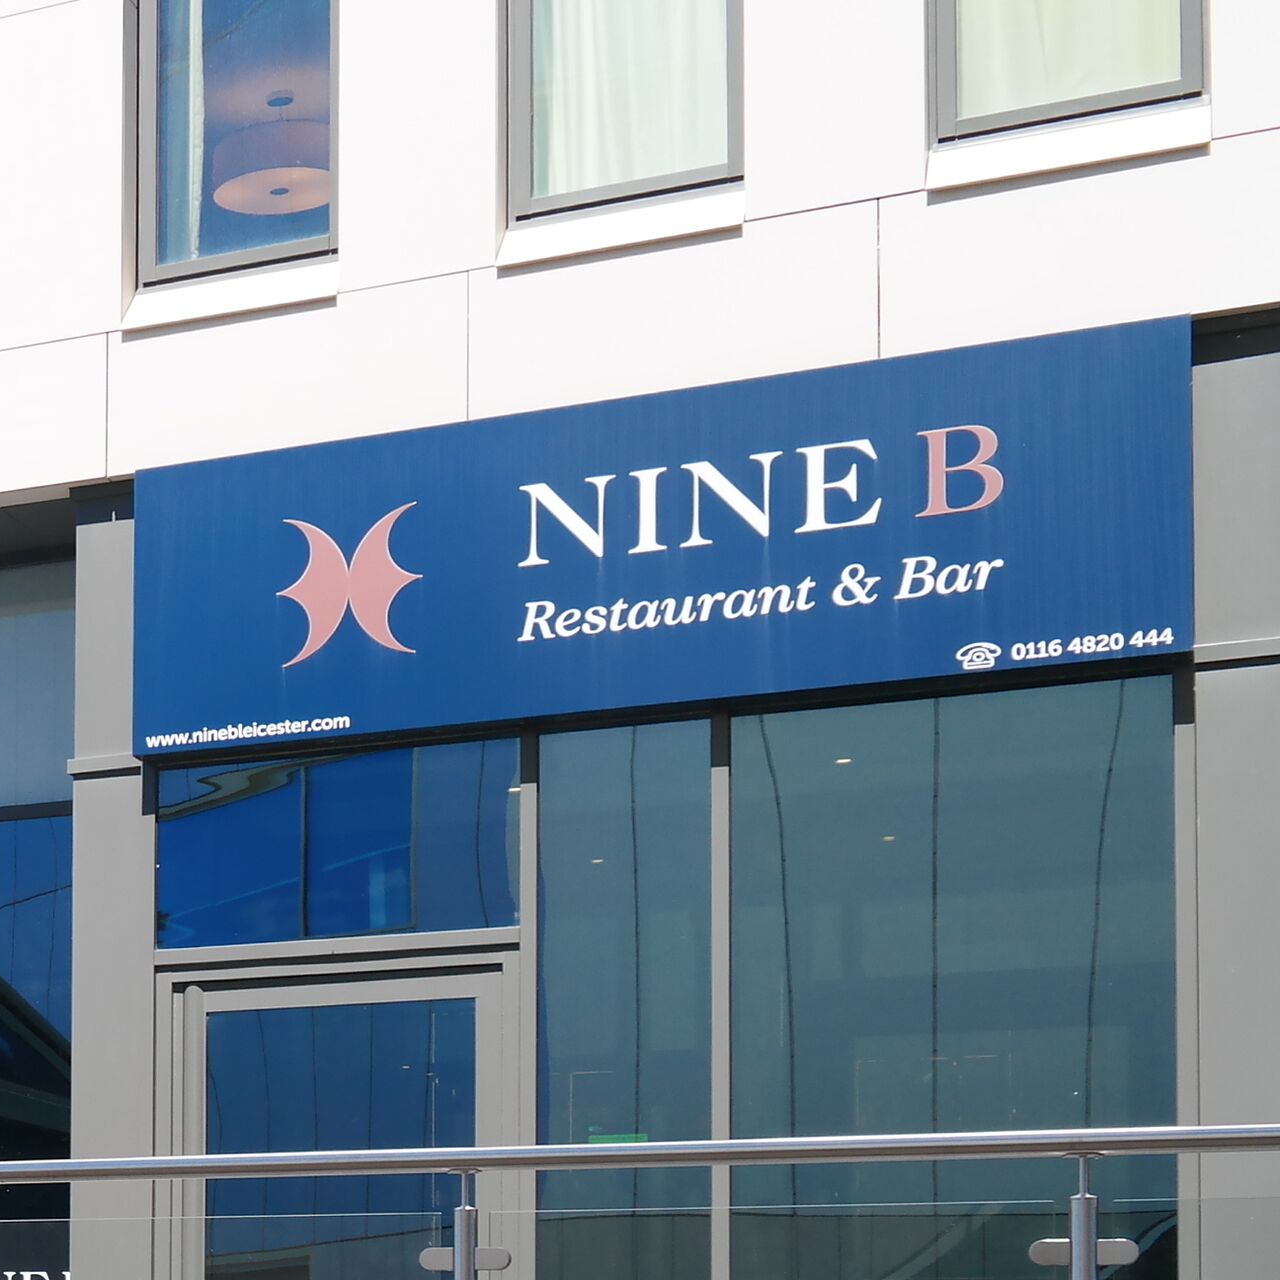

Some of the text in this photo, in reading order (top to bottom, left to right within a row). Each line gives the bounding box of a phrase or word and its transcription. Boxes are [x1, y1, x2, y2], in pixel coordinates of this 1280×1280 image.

[517, 424, 1005, 567] NINE B
[517, 554, 1005, 642] Restaurant & Bar
[1011, 627, 1174, 661] 0116 4820 444
[146, 715, 351, 748] www.ninebleicester.com
